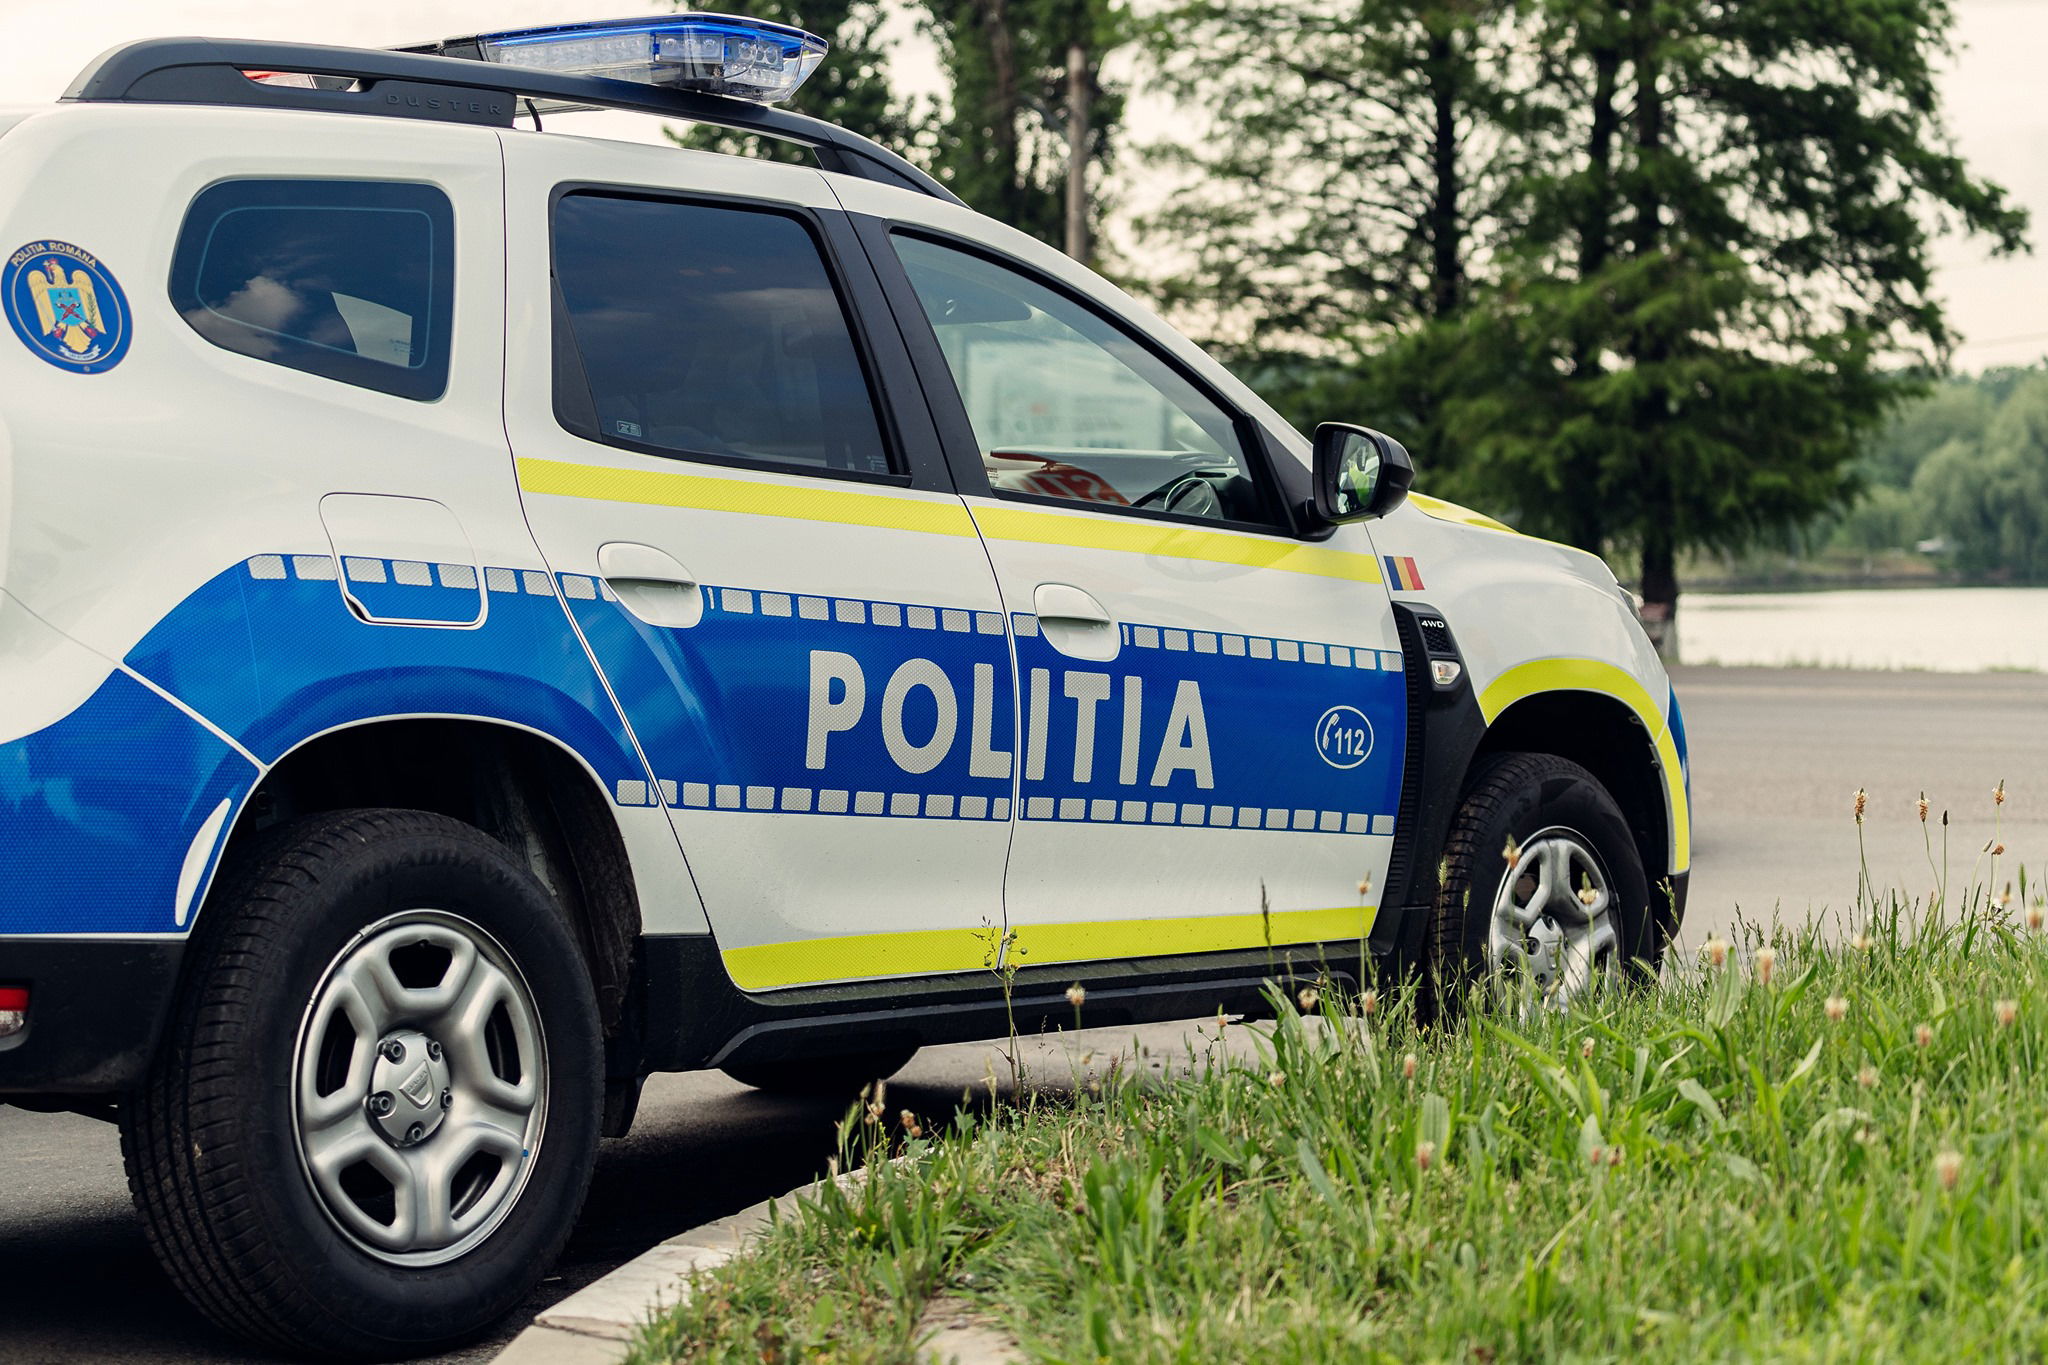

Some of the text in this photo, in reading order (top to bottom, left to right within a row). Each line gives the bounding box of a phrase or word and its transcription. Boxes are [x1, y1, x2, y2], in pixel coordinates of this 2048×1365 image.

[386, 94, 501, 116] DUSTER
[1421, 620, 1445, 628] 4WD
[806, 650, 1214, 789] POLITIA
[1334, 727, 1365, 756] 112
